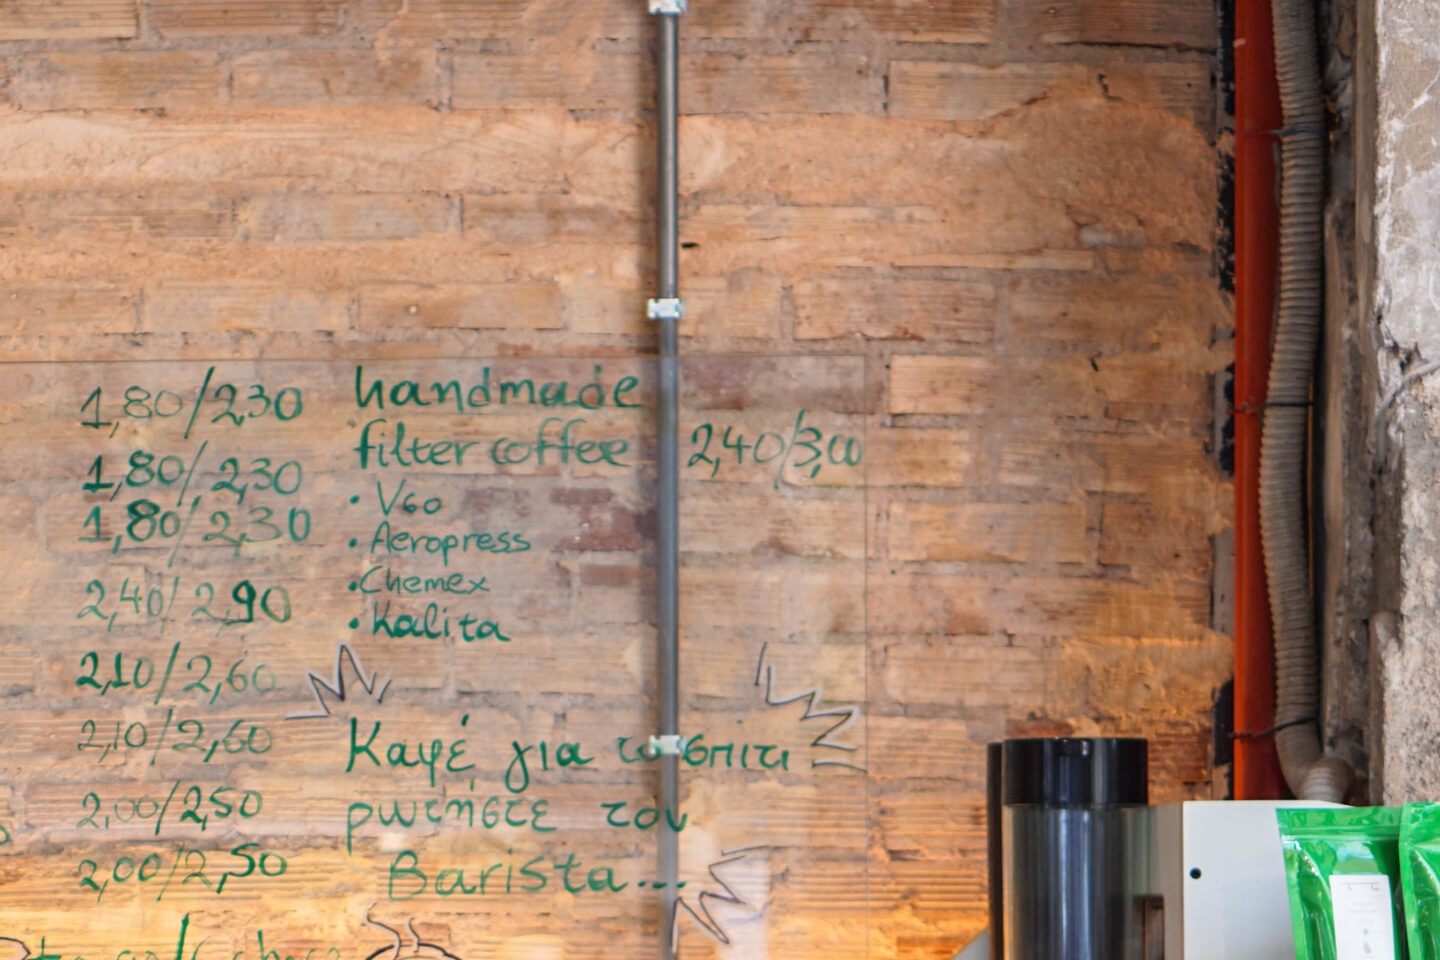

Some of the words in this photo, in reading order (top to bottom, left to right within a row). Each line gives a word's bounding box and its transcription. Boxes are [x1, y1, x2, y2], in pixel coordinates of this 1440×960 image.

[80, 365, 303, 439] 1,80/2,30
[355, 365, 642, 412] handmade
[352, 418, 478, 471] filter
[491, 417, 629, 467] coffee
[81, 441, 303, 509] 1,80/2,30
[376, 479, 442, 517] V60
[78, 493, 312, 570] 1,80/2,30
[369, 520, 532, 569] Aeropress
[356, 565, 490, 596] Chemex
[504, 740, 594, 794] για
[74, 779, 262, 836] 2,00/2,50
[78, 842, 287, 906] 2,00/2,50
